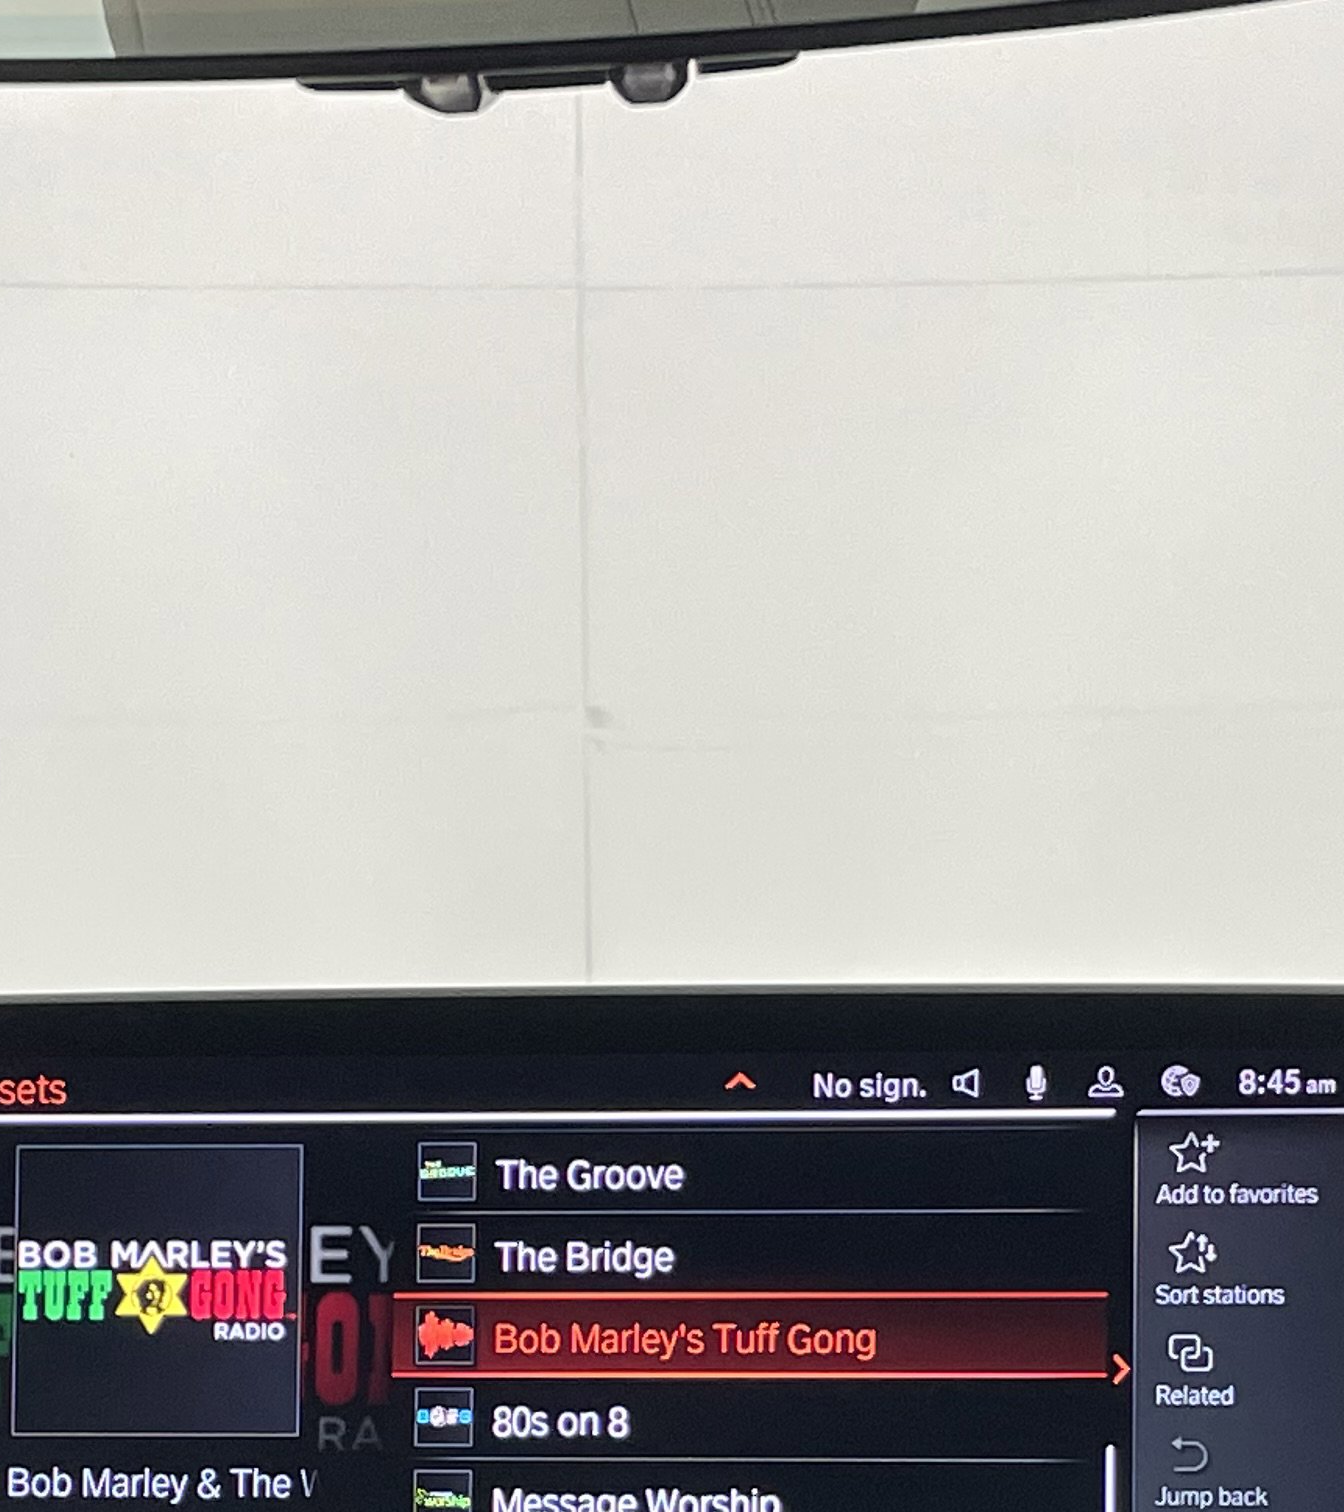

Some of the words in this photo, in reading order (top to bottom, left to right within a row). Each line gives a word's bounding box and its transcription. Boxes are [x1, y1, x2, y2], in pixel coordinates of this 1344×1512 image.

[813, 1072, 853, 1099] No
[859, 1071, 927, 1104] sign.
[1238, 1068, 1302, 1096] 8:45
[1305, 1078, 1337, 1095] am
[494, 1158, 559, 1191] The
[566, 1159, 685, 1192] Groove
[1155, 1183, 1199, 1205] Add
[1202, 1185, 1226, 1205] to
[1228, 1182, 1320, 1204] favorites
[17, 1240, 98, 1270] BOB
[493, 1240, 559, 1274] The
[566, 1240, 676, 1280] Bridge
[18, 1267, 114, 1321] TUFF
[190, 1269, 287, 1320] GONG
[1155, 1284, 1197, 1305] Sort
[1202, 1284, 1286, 1305] stations
[213, 1320, 287, 1341] RADIO
[494, 1322, 562, 1355] Bob
[570, 1322, 705, 1361] Marley's
[712, 1321, 780, 1355] Tuff
[786, 1323, 877, 1362] Gong
[1155, 1384, 1235, 1406] Related
[491, 1405, 550, 1439] 80s
[556, 1411, 603, 1438] on
[607, 1405, 631, 1439] 8
[7, 1465, 73, 1498] Bob
[82, 1467, 189, 1505] Marley
[196, 1467, 222, 1501] &
[229, 1467, 293, 1499] The
[1154, 1485, 1214, 1510] Jump
[1217, 1486, 1269, 1507] back
